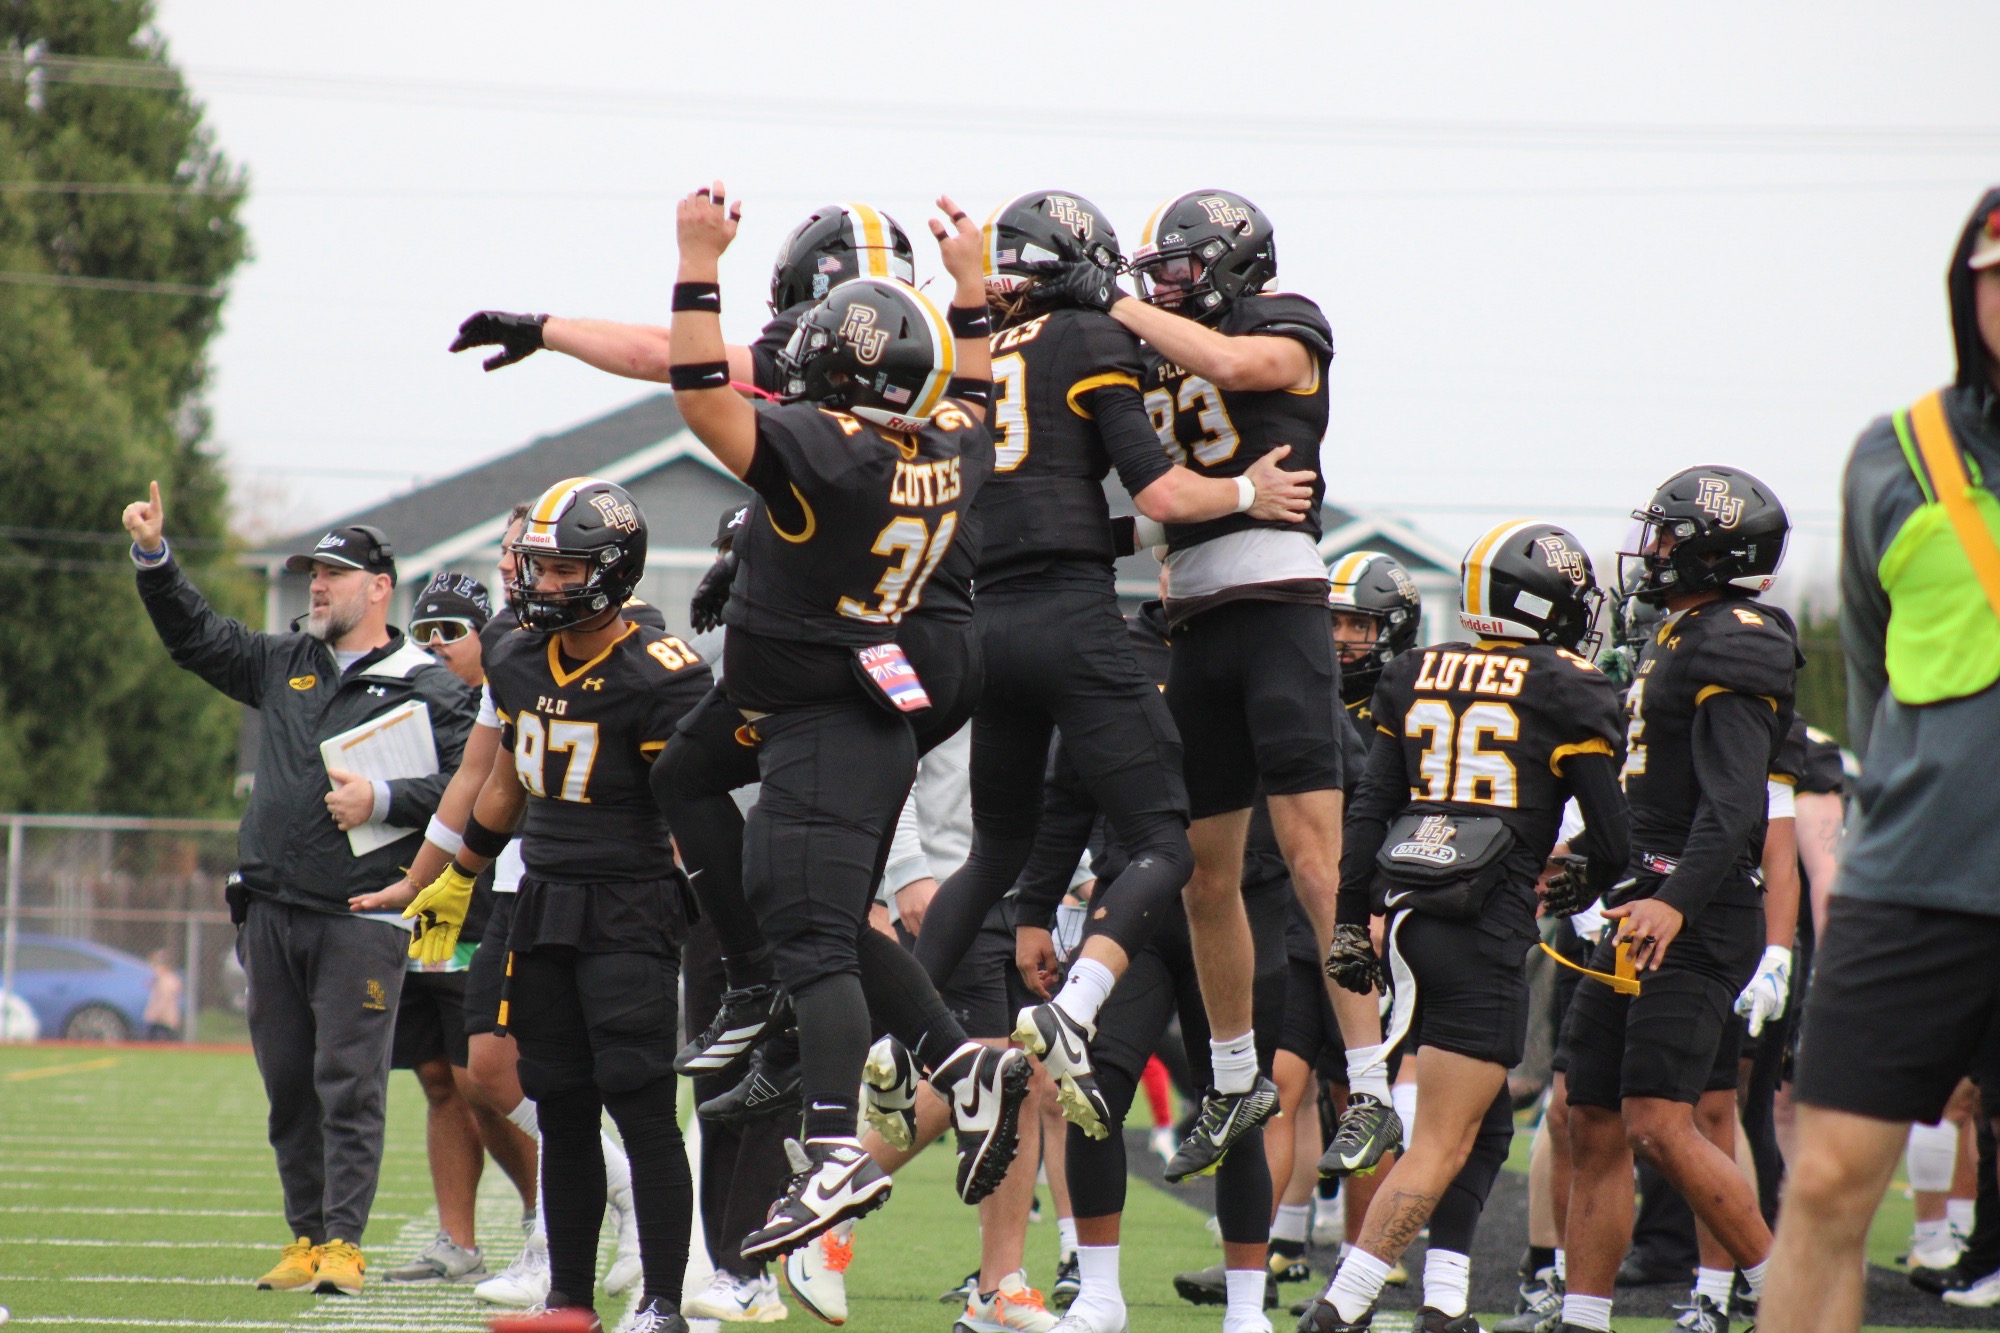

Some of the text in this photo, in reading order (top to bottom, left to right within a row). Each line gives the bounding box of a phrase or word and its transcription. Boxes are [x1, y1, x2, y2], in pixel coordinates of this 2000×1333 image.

[1047, 195, 1093, 240] PLU
[1197, 197, 1253, 237] PLU
[840, 303, 890, 365] PLU
[890, 455, 961, 507] LUTES
[1695, 478, 1744, 529] PLU
[525, 534, 551, 544] Riddell
[1536, 537, 1587, 586] PLU
[835, 510, 957, 624] 31
[1459, 615, 1504, 634] Riddell
[647, 636, 699, 671] 87
[1414, 651, 1529, 696] LUTES
[536, 695, 568, 715] PLU
[515, 710, 599, 803] 87
[1405, 698, 1519, 809] 36
